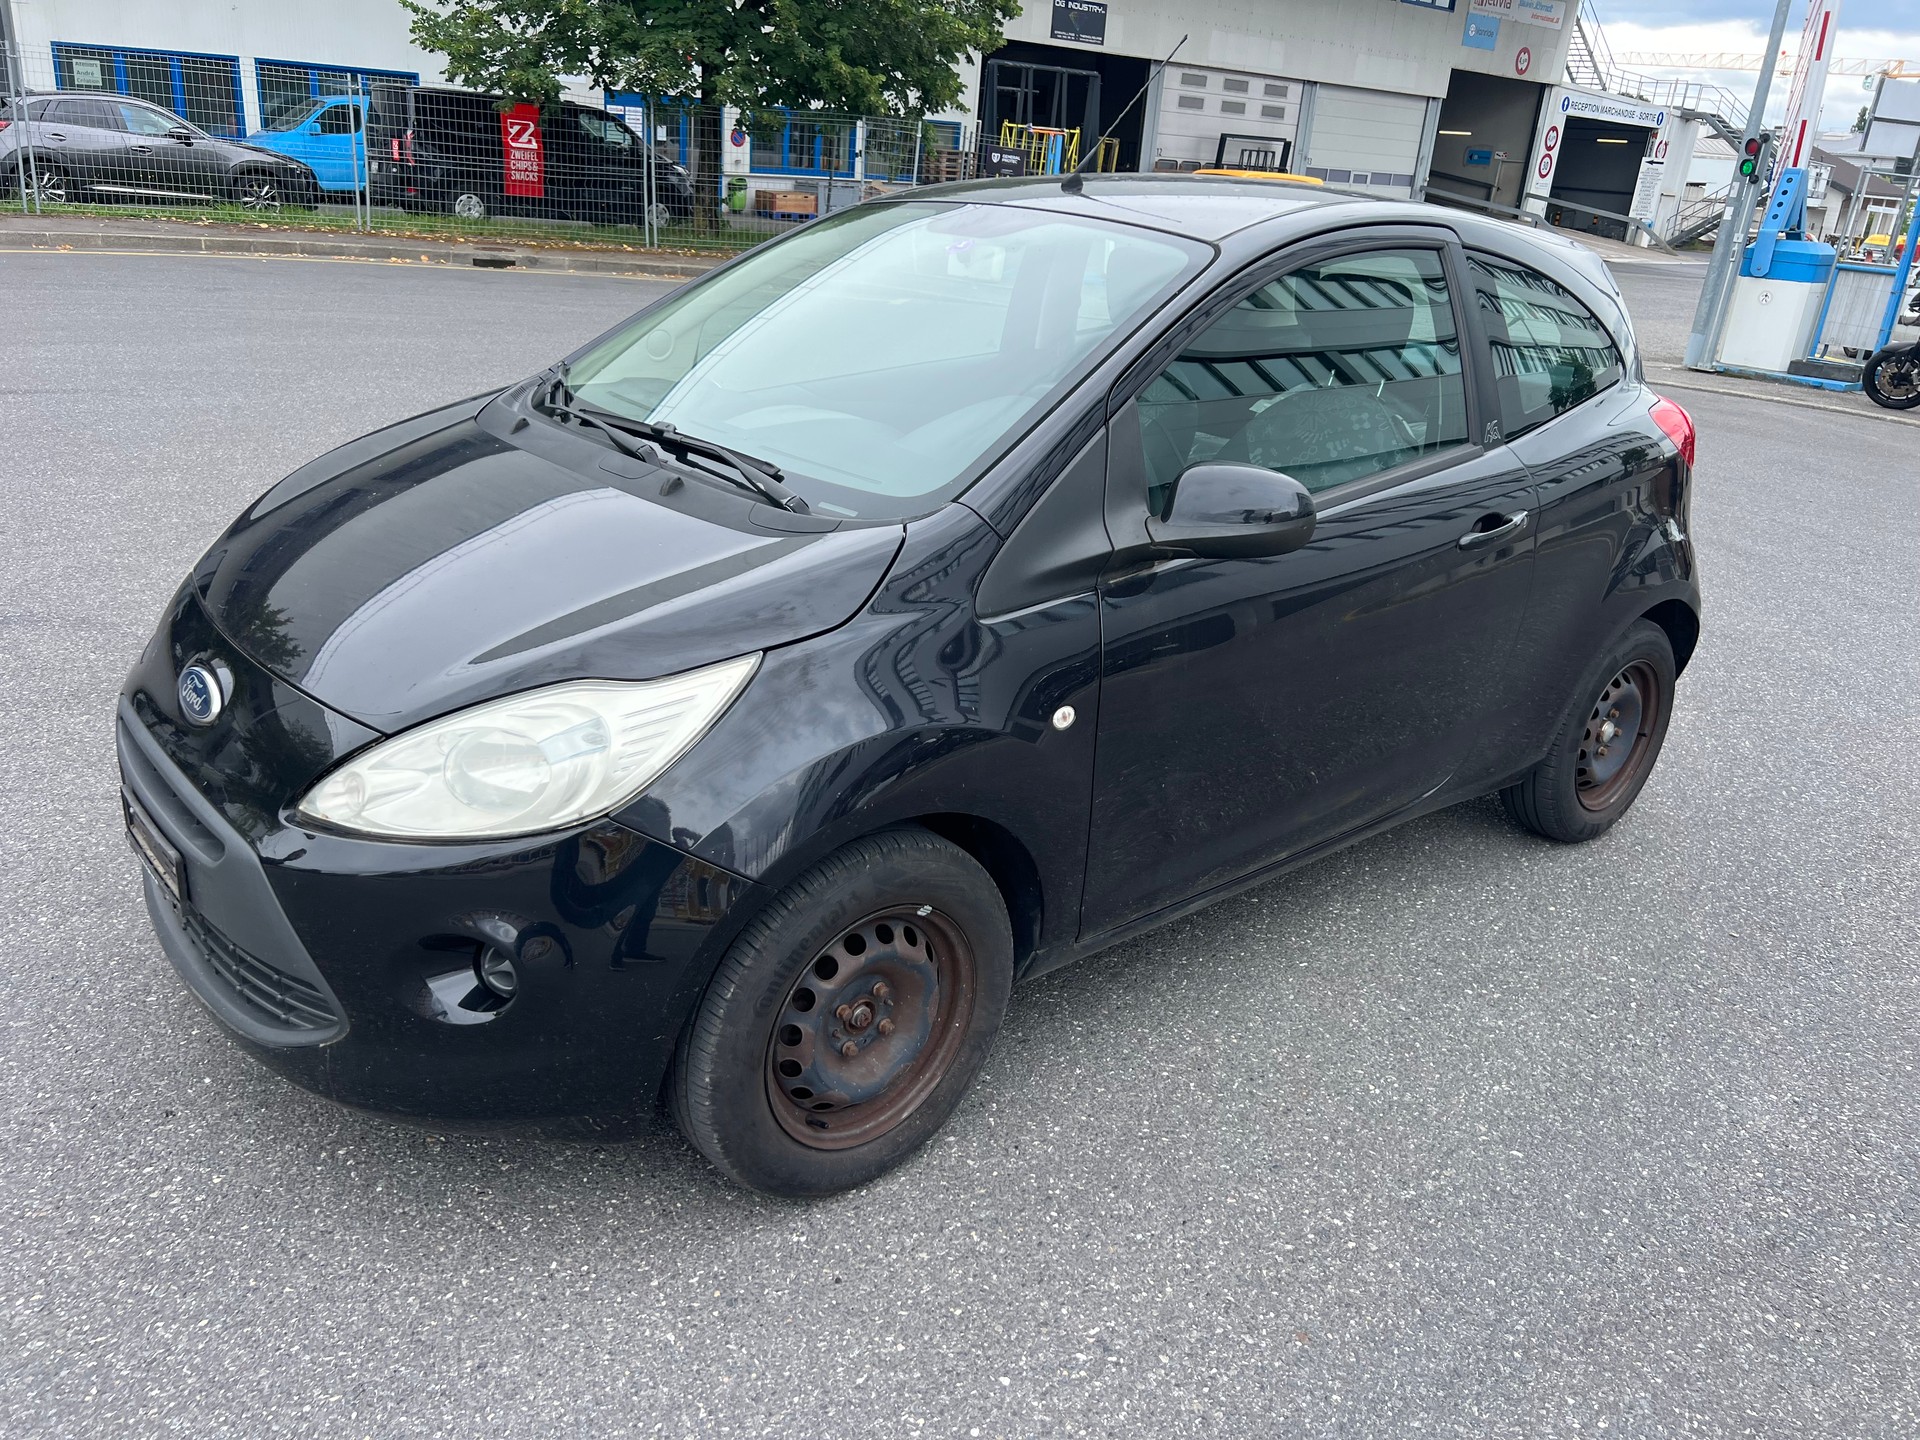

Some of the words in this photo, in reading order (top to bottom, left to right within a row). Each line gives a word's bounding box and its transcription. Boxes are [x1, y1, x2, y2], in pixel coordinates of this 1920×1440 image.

[1068, 1, 1103, 13] INDUSTRY
[1570, 100, 1600, 113] RECEPTION
[1600, 105, 1637, 119] MARCHANDISE
[1638, 112, 1657, 122] SORTIE
[510, 149, 538, 161] ZWEIFEL
[1156, 148, 1162, 157] 12
[510, 170, 538, 182] SNACKS
[182, 675, 207, 711] Ford
